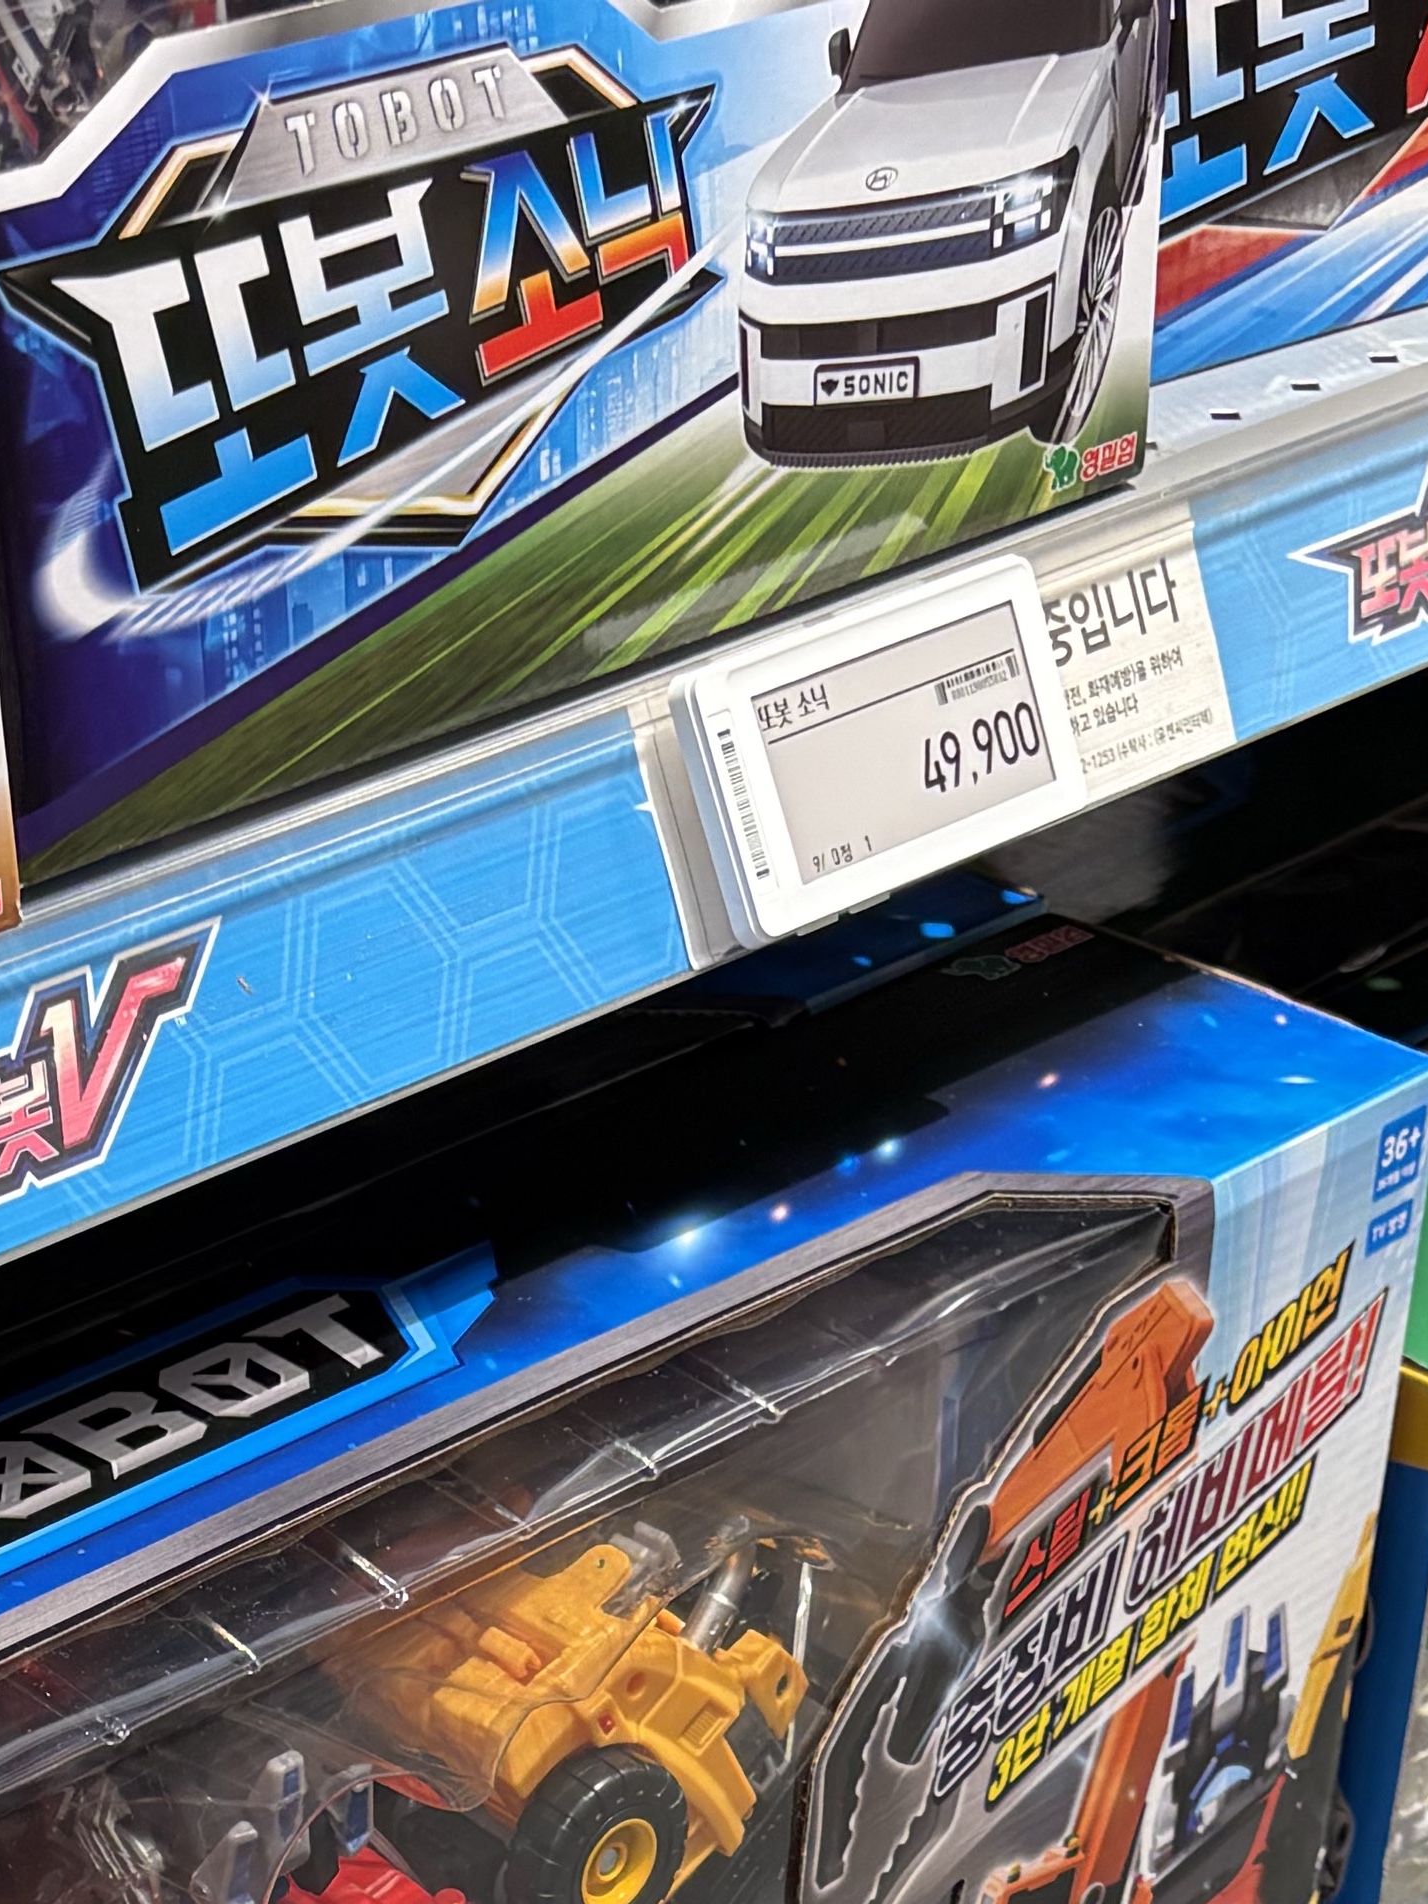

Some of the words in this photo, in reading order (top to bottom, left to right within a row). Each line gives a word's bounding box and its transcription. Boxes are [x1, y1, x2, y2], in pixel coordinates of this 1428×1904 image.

[284, 67, 509, 178] TOBOT
[52, 176, 465, 554] 또봇
[462, 106, 696, 382] 소닉
[843, 366, 910, 397] SONIC
[1080, 433, 1138, 480] 영실업
[757, 696, 794, 733] 또봇
[797, 683, 831, 718] 소닉
[1092, 692, 1140, 728] 있습니다
[923, 701, 1040, 793] 49,900
[1380, 1126, 1422, 1169] 36+
